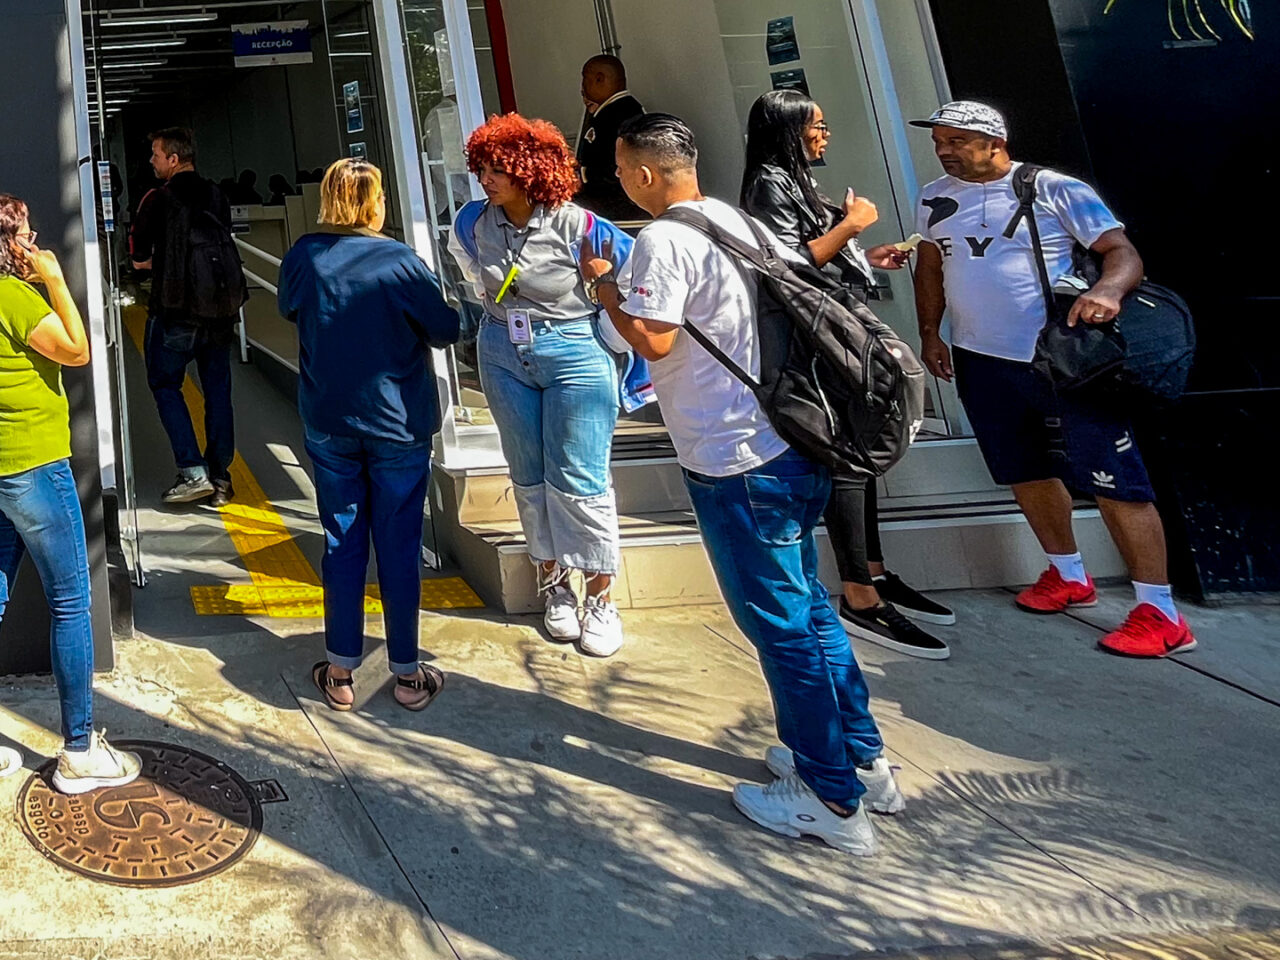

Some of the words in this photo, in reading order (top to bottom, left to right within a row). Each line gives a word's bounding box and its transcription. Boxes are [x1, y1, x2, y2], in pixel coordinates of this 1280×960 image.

[251, 39, 293, 48] RECEPÇÃO
[29, 796, 49, 838] esgoto
[68, 794, 90, 834] abesp
